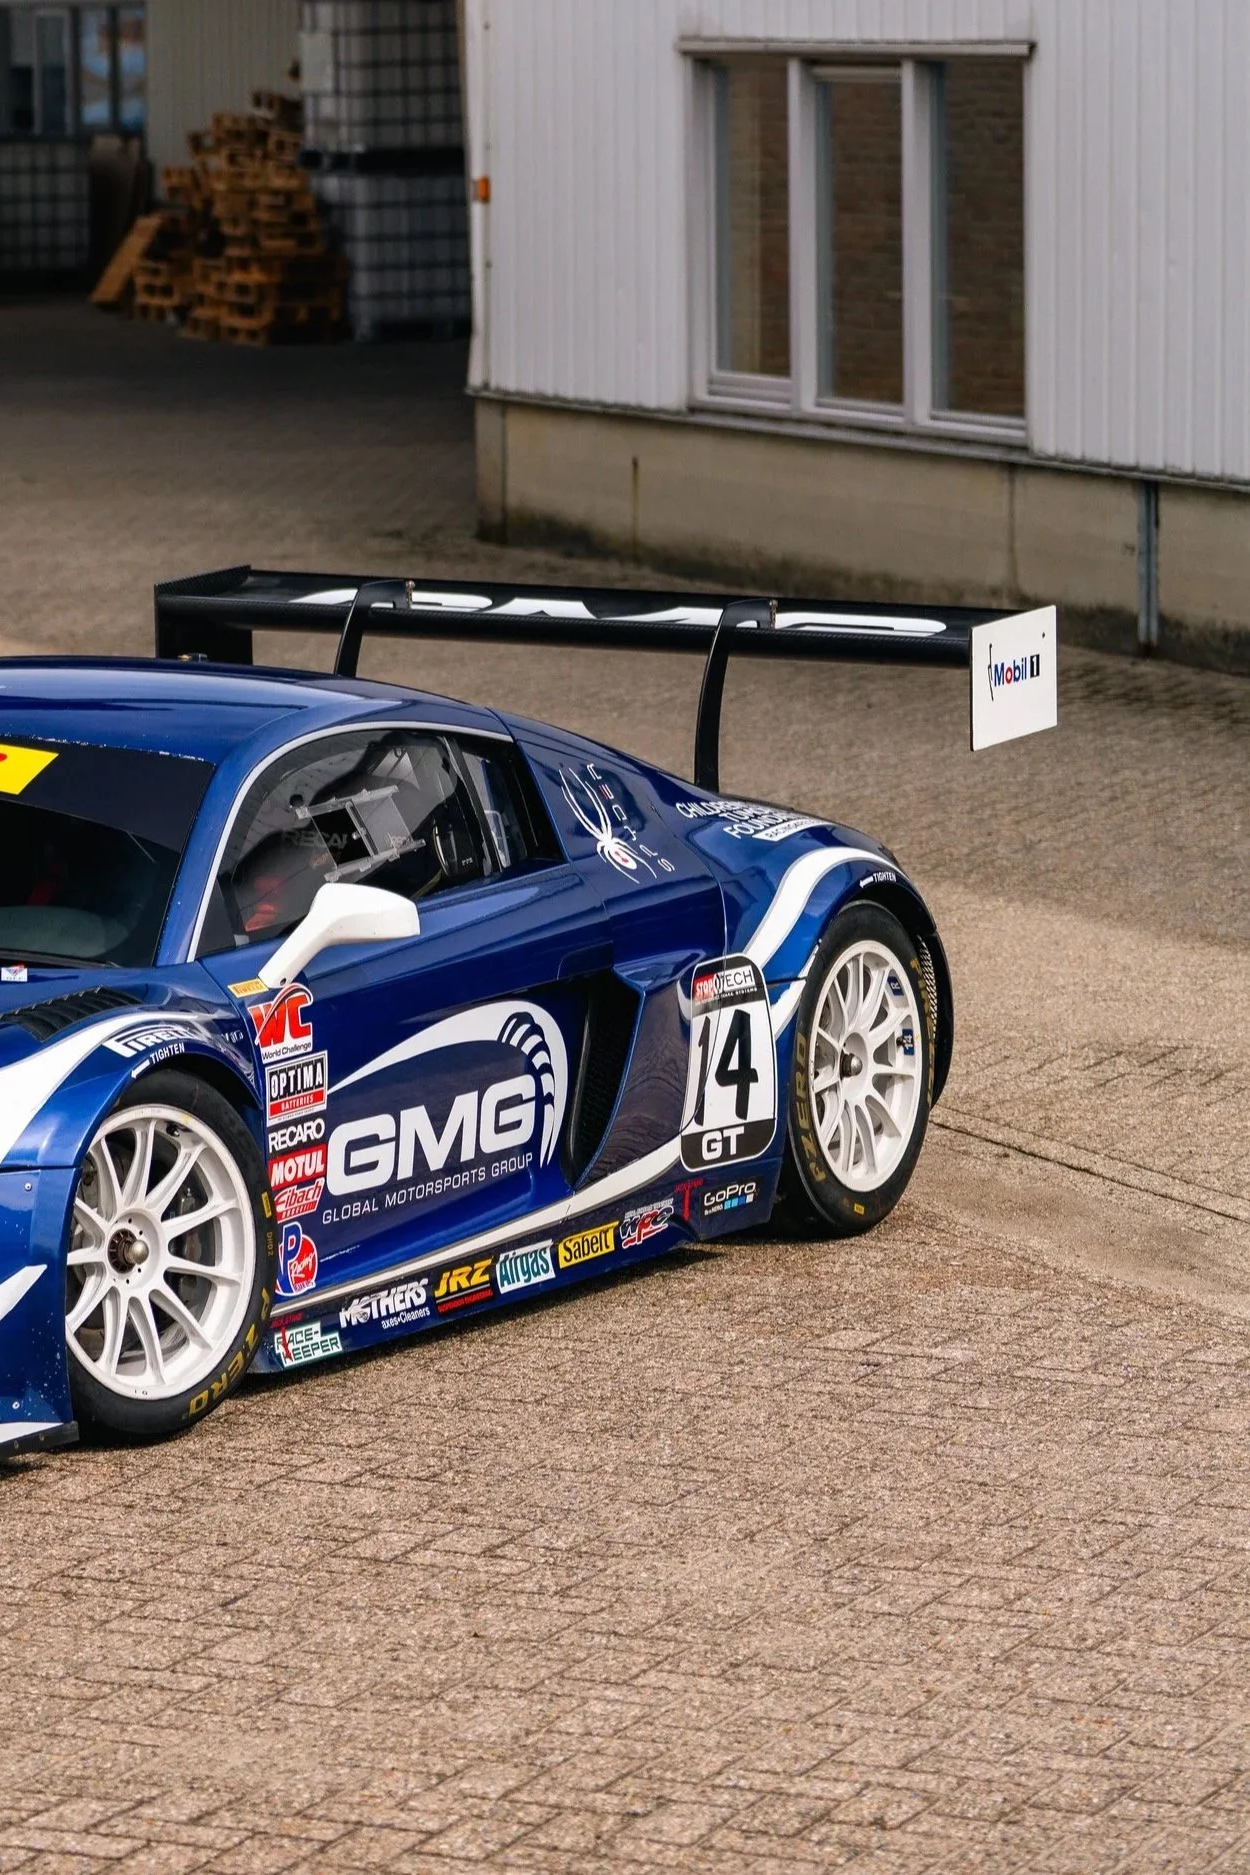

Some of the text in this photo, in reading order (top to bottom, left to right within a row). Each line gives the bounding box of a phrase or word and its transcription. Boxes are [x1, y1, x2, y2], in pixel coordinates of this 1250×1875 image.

[994, 654, 1039, 687] Mobil 1
[587, 763, 675, 872] SPYDER
[873, 871, 897, 883] TIGHTEN
[249, 994, 312, 1048] WC
[149, 1042, 185, 1064] TIGHTEN
[262, 1042, 312, 1060] World Challenge
[694, 1009, 758, 1126] 14
[270, 1062, 323, 1098] OPTIMA
[281, 1094, 314, 1111] BATTERIES
[268, 1118, 325, 1153] RECARO
[326, 1074, 535, 1196] GMG
[702, 1126, 745, 1161] GT
[270, 1150, 324, 1187] MOTUL
[275, 1181, 322, 1209] Eibach
[322, 1152, 533, 1224] GLOBAL MOTORSPORTS GROUP
[704, 1182, 757, 1207] GoPro
[434, 1256, 494, 1297] JRZ
[499, 1247, 550, 1288] Airgas
[339, 1278, 428, 1328] MOTHERS
